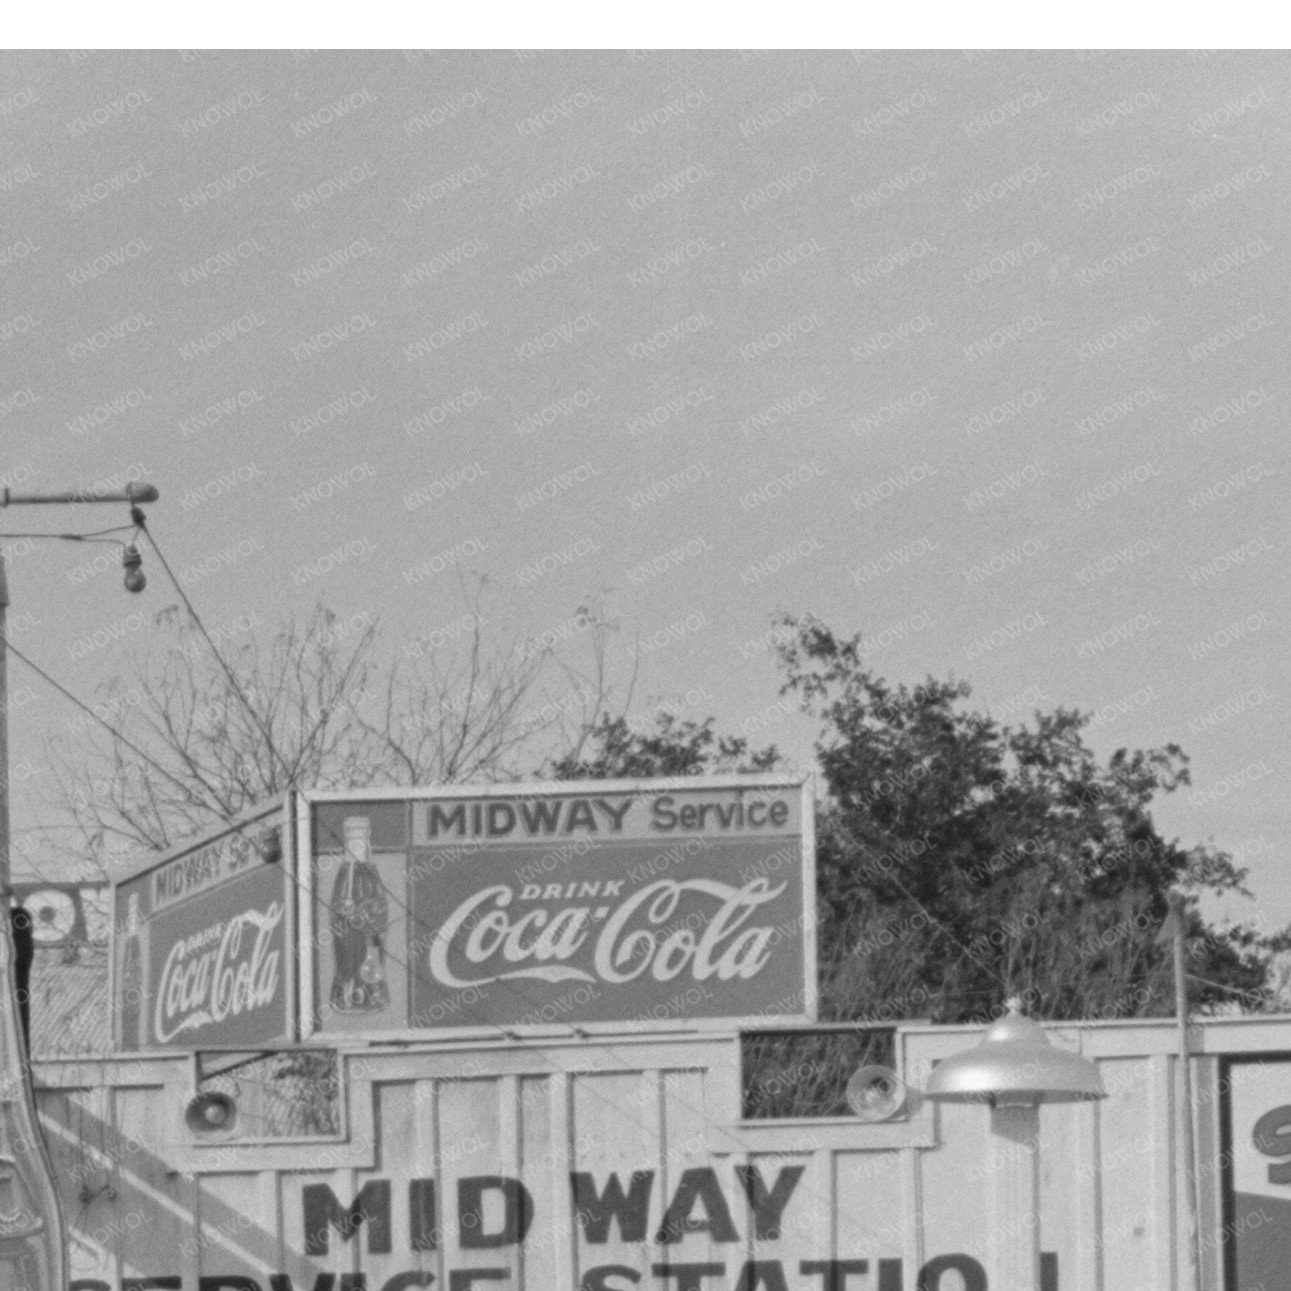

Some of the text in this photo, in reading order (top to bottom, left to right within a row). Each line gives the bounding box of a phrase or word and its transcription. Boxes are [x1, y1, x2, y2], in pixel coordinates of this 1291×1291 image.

[427, 796, 791, 839] MIDWAY Service
[156, 840, 225, 897] MIDWAY
[521, 880, 625, 900] DRINK
